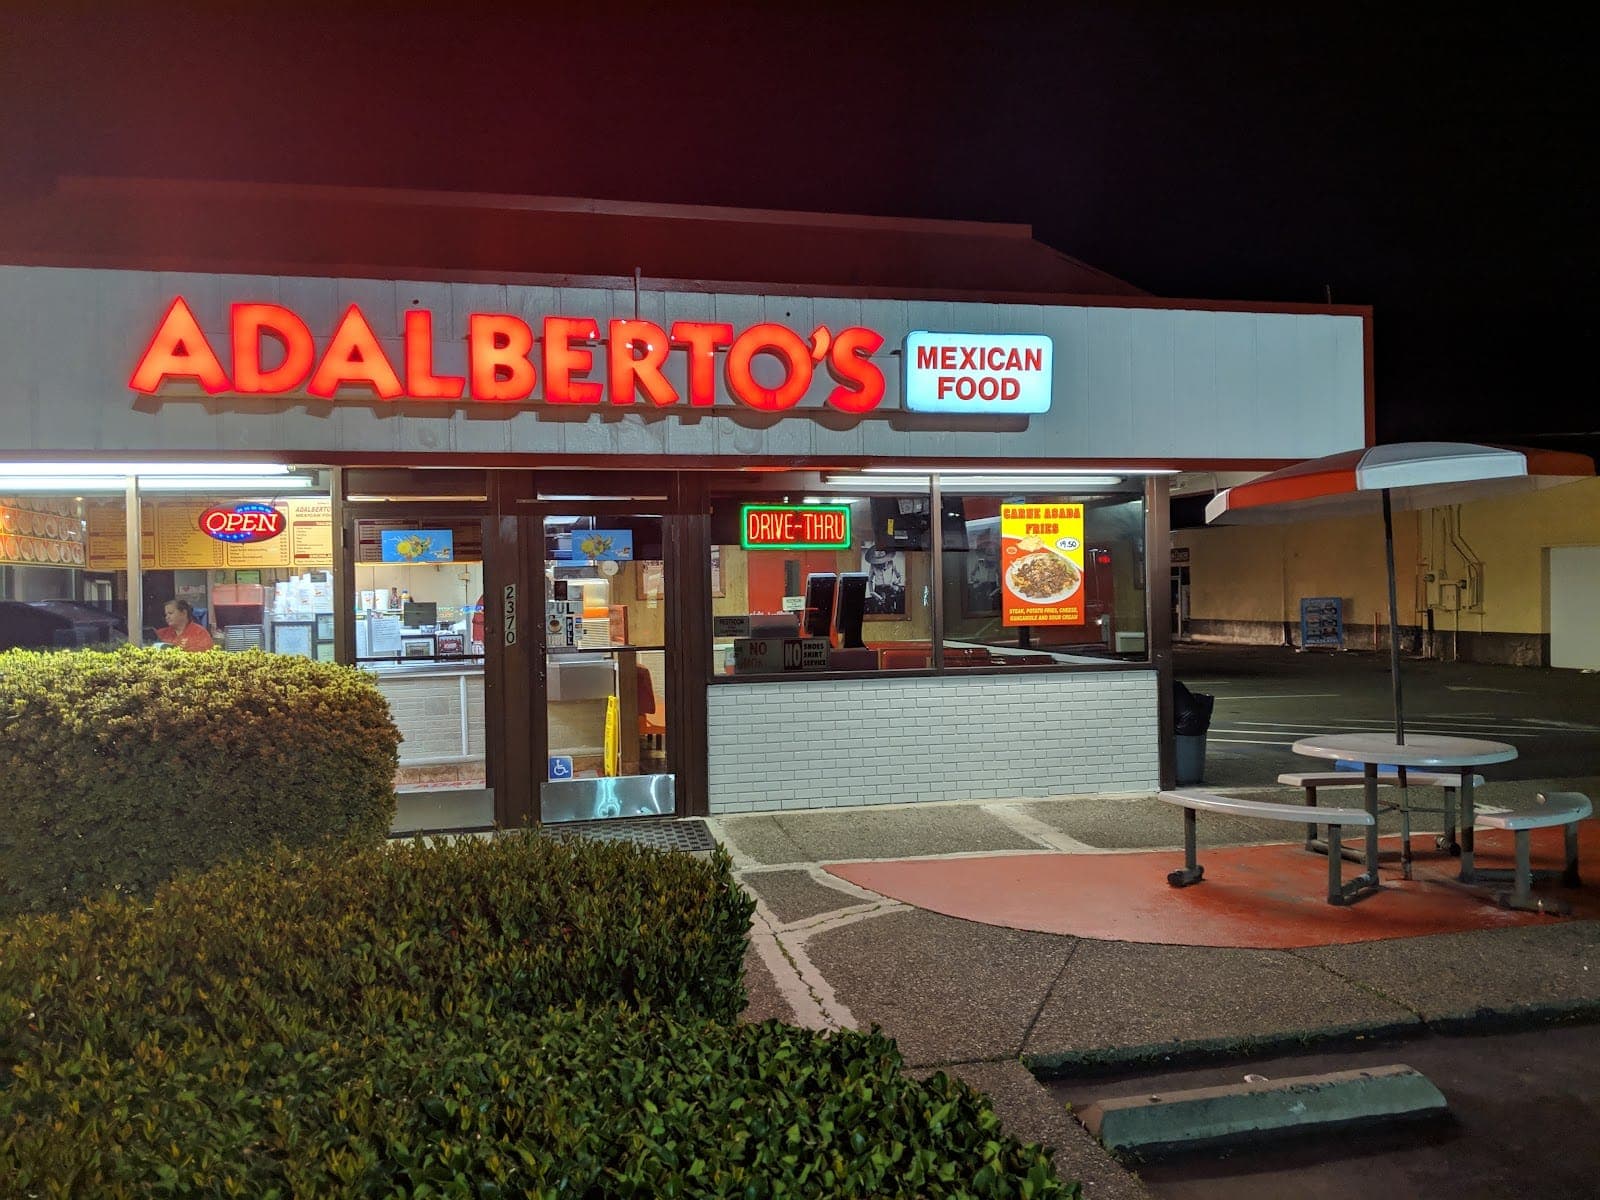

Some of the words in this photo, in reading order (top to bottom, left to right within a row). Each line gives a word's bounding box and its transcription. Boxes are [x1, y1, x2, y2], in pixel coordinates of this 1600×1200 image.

[129, 296, 885, 414] ADALBERTO'S
[916, 345, 1042, 373] MEXICAN
[937, 376, 1021, 402] FOOD
[206, 512, 278, 532] OPEN
[749, 513, 845, 540] DRIVE-THRU
[1003, 508, 1041, 519] CARNE
[1044, 508, 1081, 519] ASADA
[1025, 523, 1059, 534] FRIES
[505, 586, 515, 644] 2370
[750, 641, 767, 656] NO
[784, 642, 802, 669] NO
